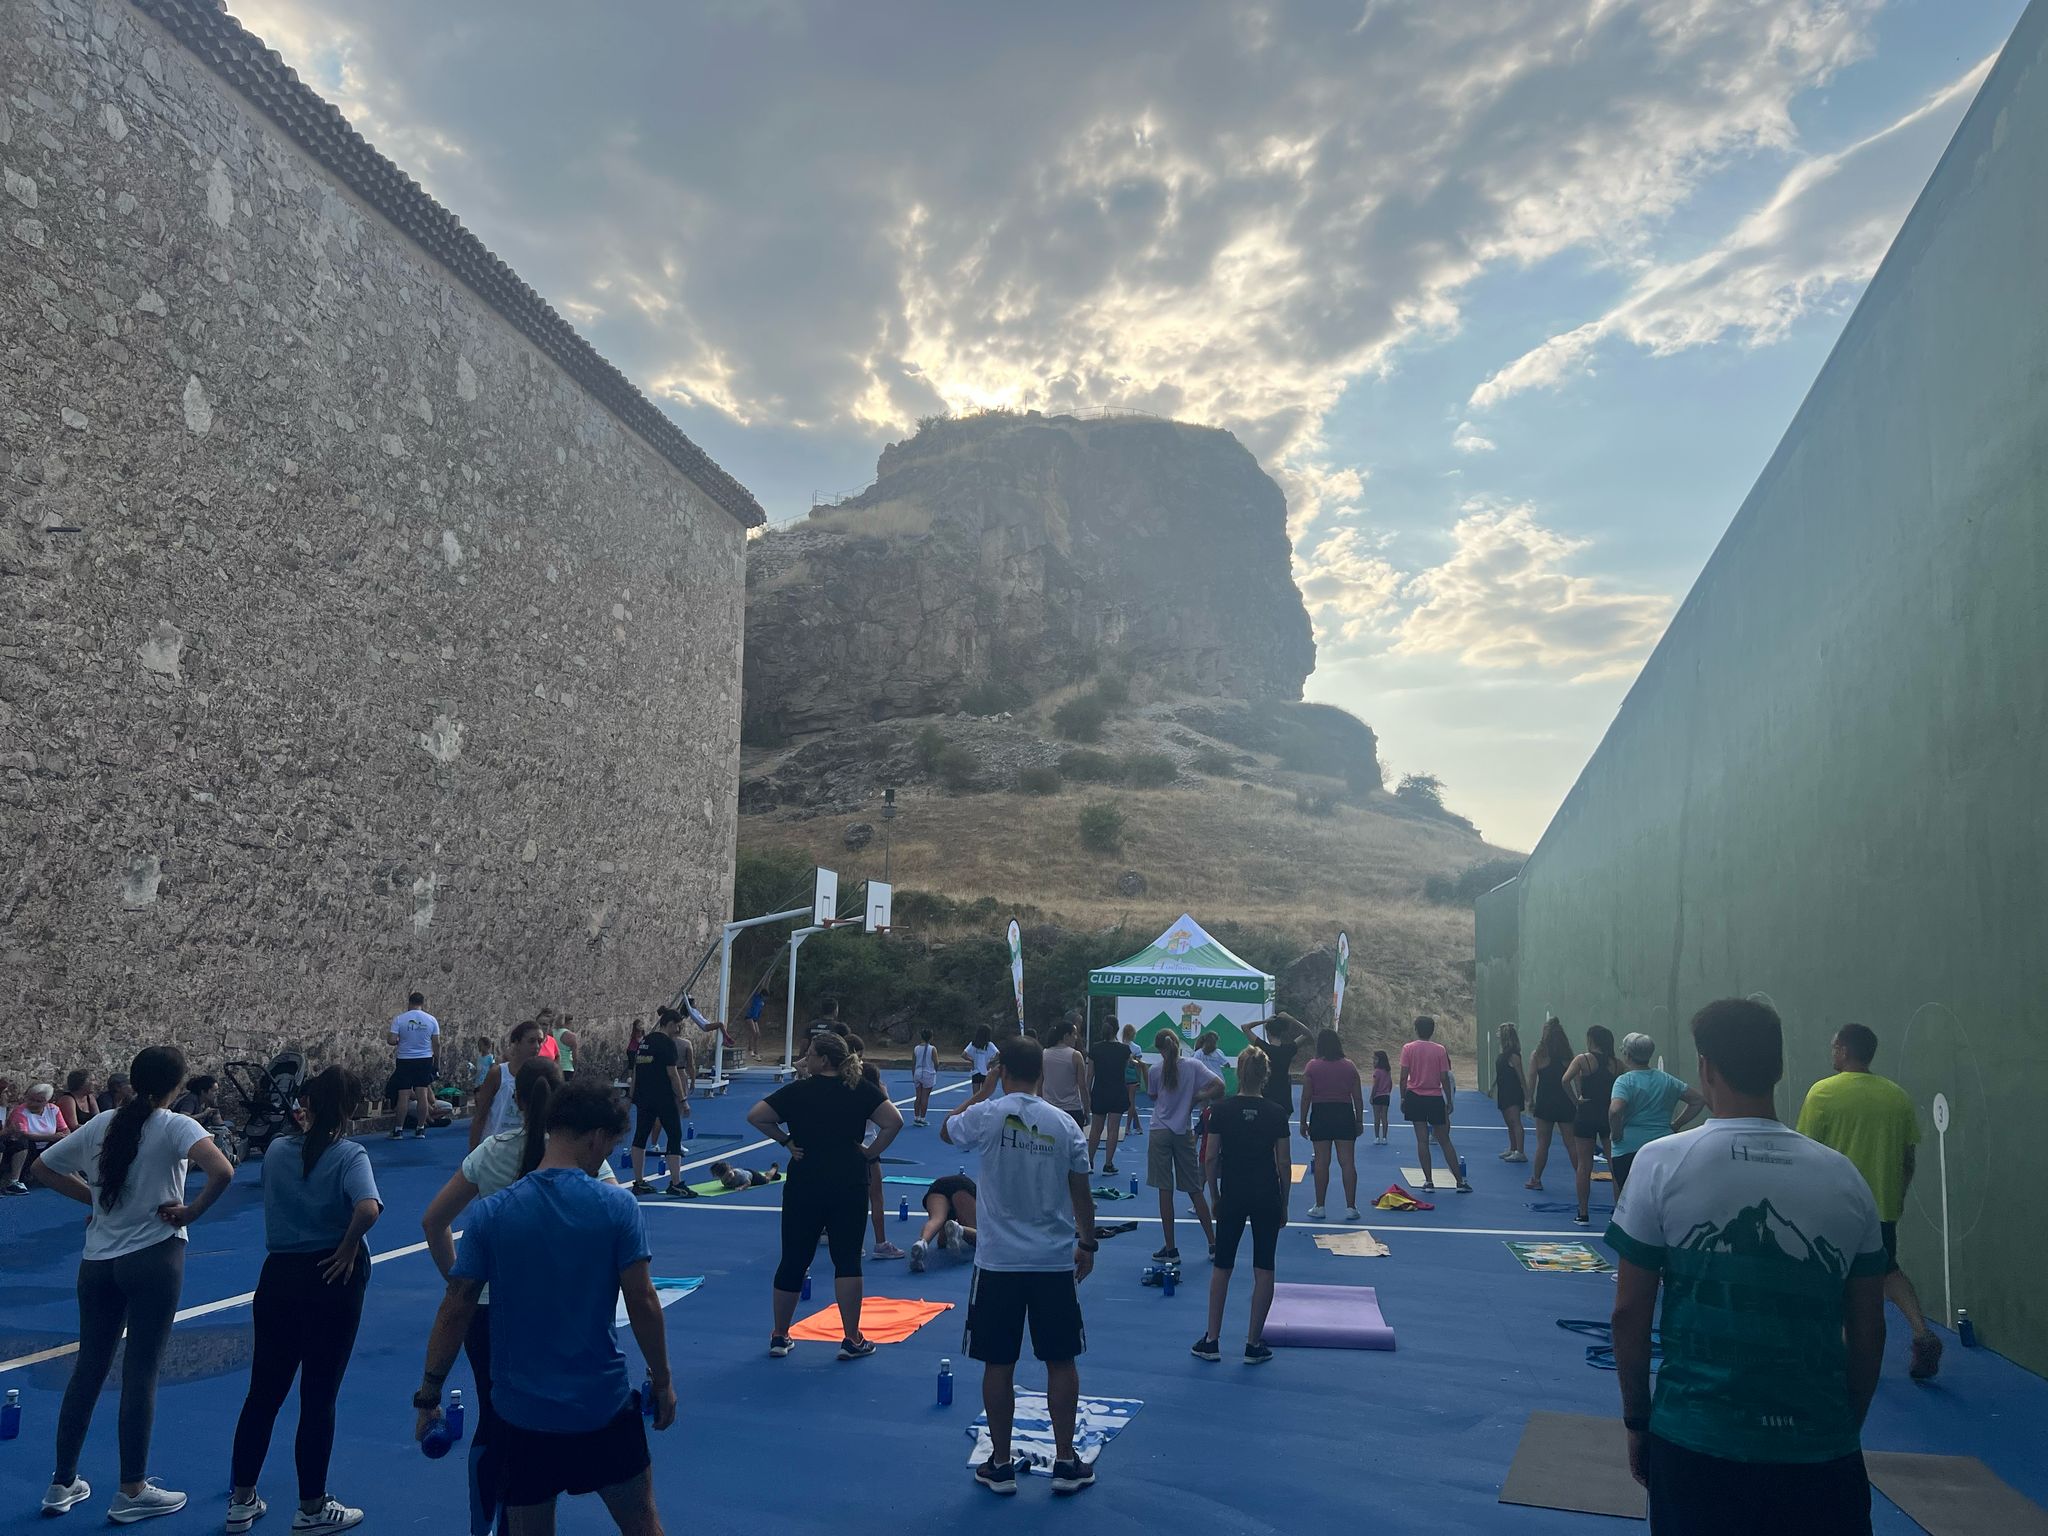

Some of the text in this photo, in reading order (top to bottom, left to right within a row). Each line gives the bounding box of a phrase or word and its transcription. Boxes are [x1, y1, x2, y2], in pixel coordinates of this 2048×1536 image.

[1090, 974, 1259, 991] CLUB DEPORTIVO HUÉLAMO
[1154, 988, 1191, 997] CUENCA
